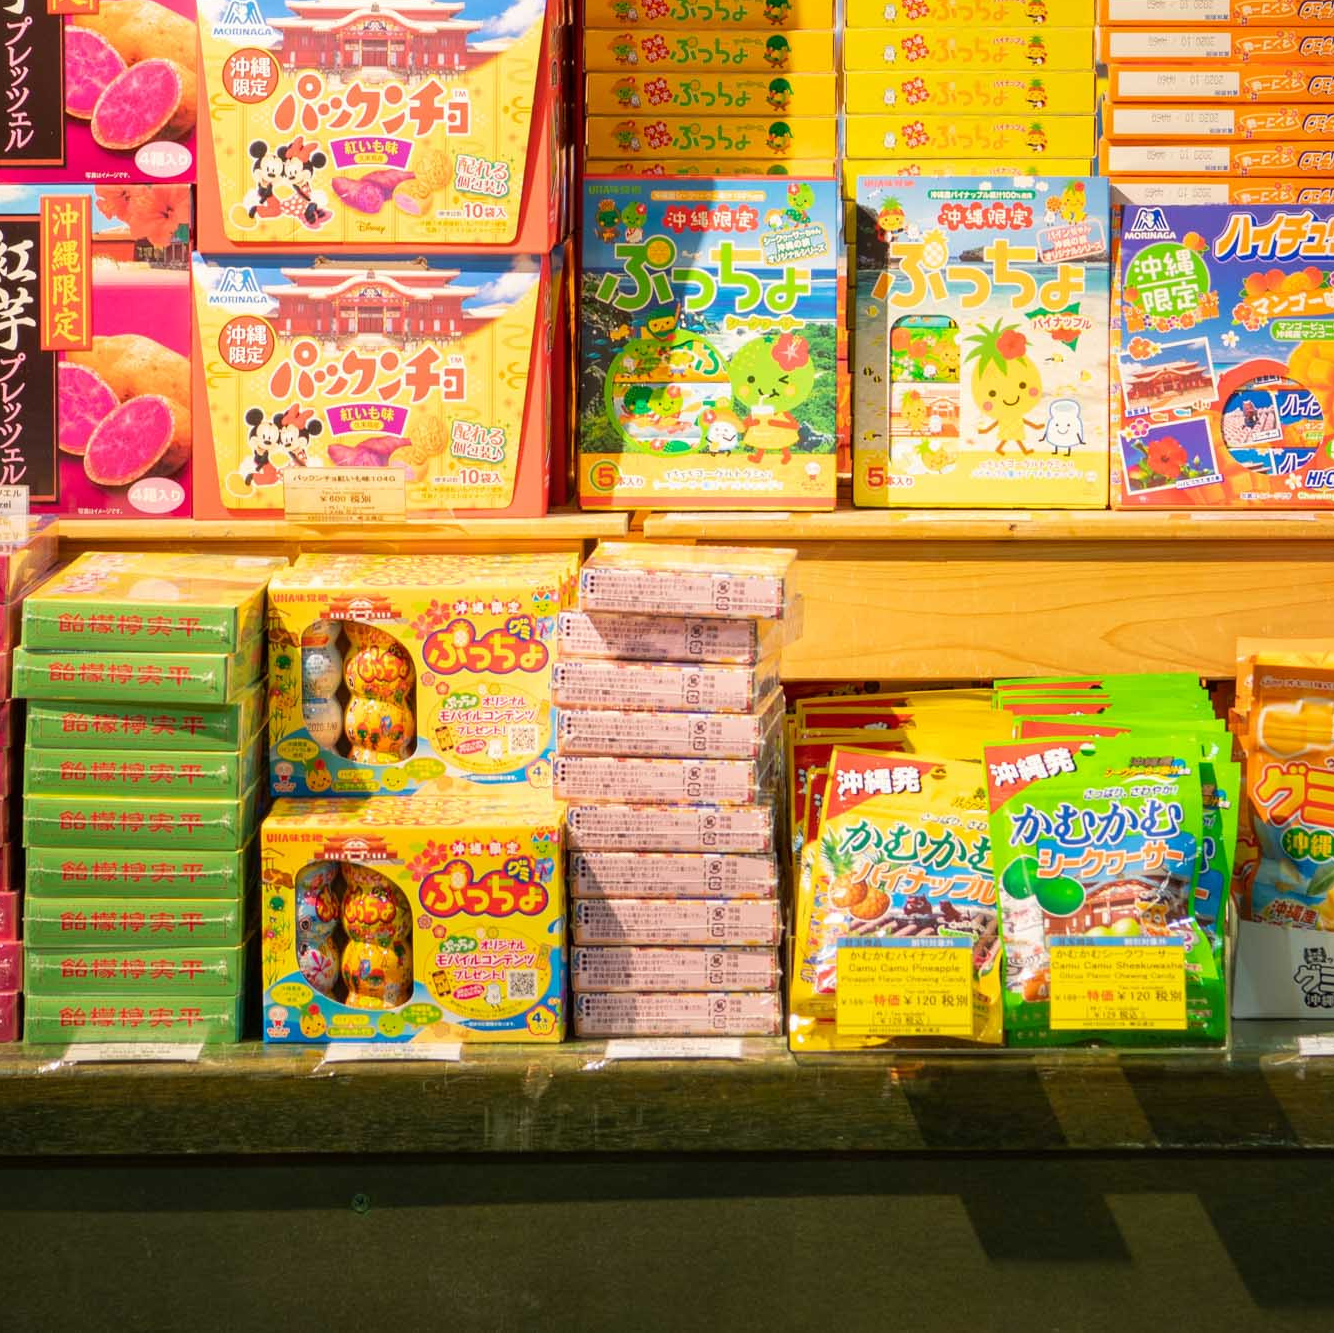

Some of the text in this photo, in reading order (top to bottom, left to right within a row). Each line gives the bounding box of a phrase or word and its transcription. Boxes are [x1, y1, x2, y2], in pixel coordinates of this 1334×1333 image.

[212, 27, 273, 37] MORINAGA
[230, 57, 271, 77] 沖縄
[233, 78, 268, 97] 限定
[273, 73, 469, 136] パックンチョ
[343, 140, 399, 155] 紅いも味
[667, 210, 754, 229] 沖縄限定
[942, 209, 1029, 227] 沖縄限定
[1124, 231, 1177, 240] MORINAGA
[51, 203, 81, 343] 沖縄限定
[595, 236, 811, 312] ぷっちょ
[872, 238, 1085, 309] ぷっちょ
[1134, 249, 1195, 282] 沖縄
[208, 295, 269, 304] MORINAGA
[1142, 282, 1199, 312] 限定
[226, 324, 268, 345] 沖縄
[229, 346, 264, 364] 限定
[270, 340, 465, 403] パックンチョ
[340, 406, 395, 421] 紅いも味
[990, 747, 1077, 787] 沖縄発
[836, 767, 921, 796] 沖縄発
[1010, 803, 1183, 847] かむかむ
